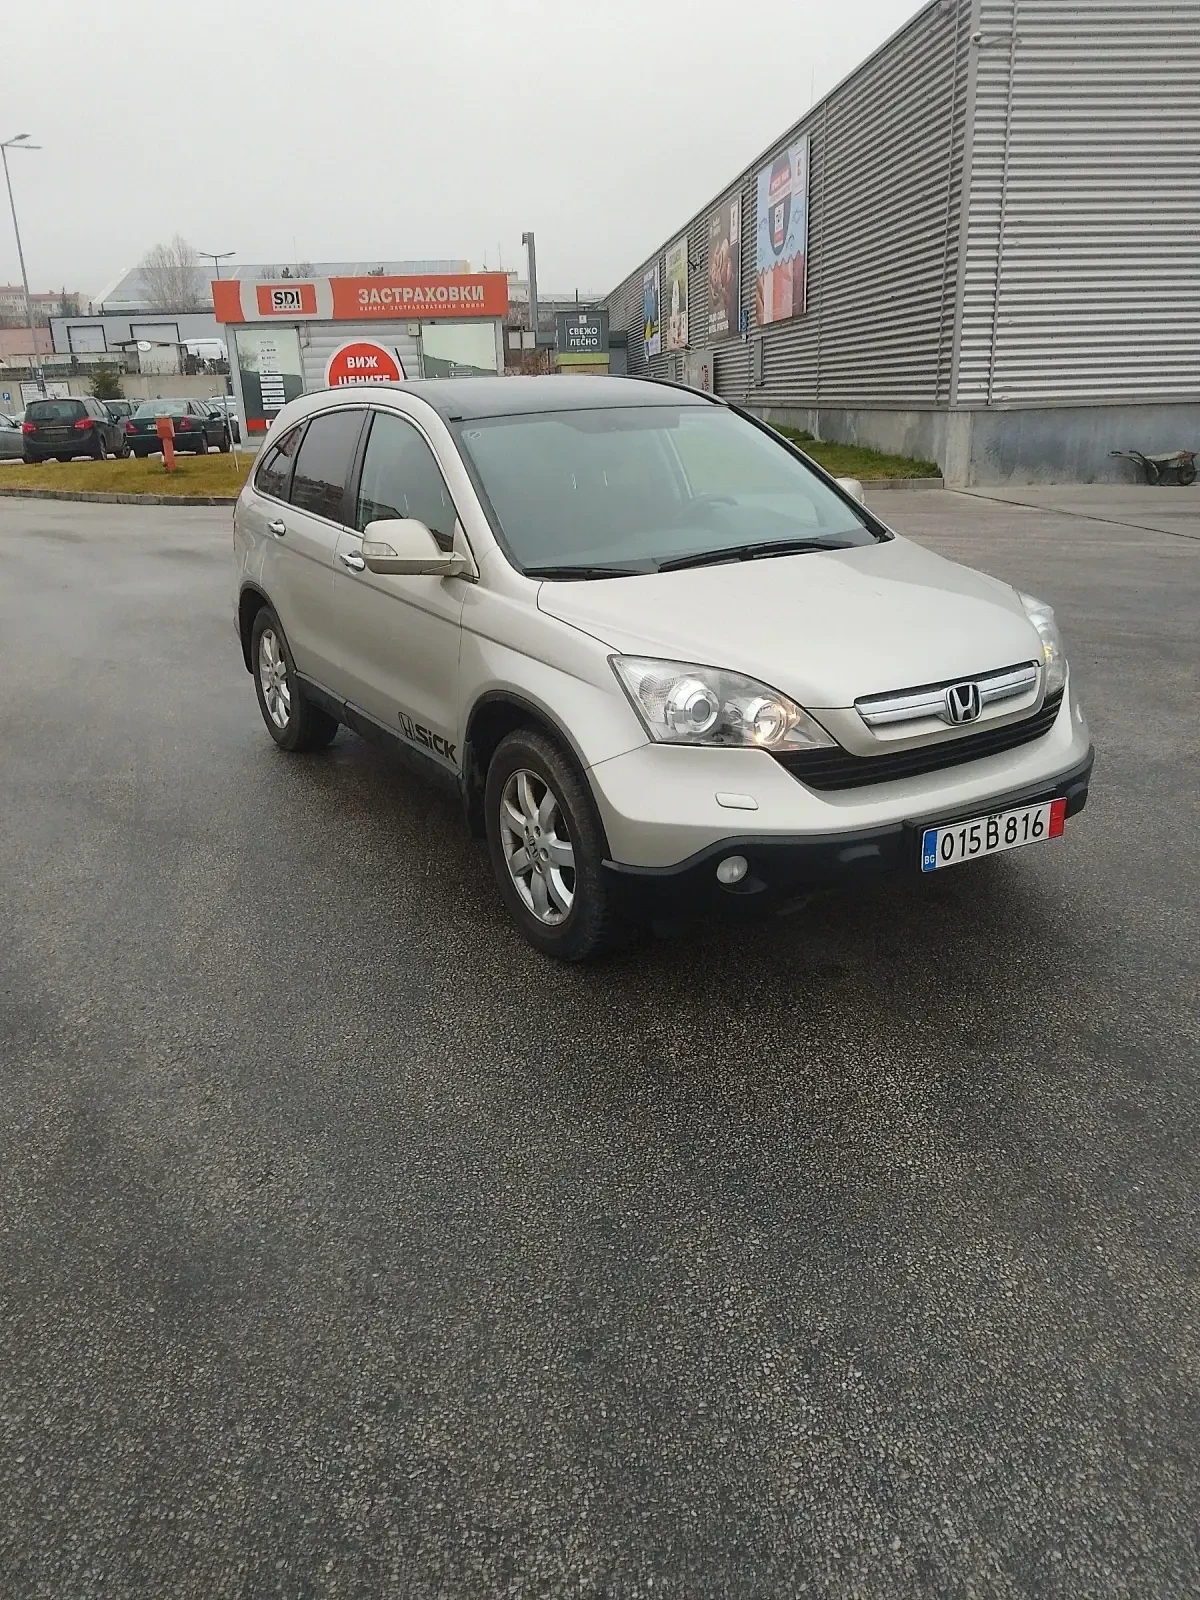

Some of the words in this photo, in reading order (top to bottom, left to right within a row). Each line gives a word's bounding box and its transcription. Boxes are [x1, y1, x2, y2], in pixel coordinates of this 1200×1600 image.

[273, 291, 301, 305] SDI
[358, 286, 485, 303] ЗАСТРАХОВКИ
[569, 327, 598, 335] СВЕЖО
[570, 338, 598, 346] ЛЕСНО
[346, 356, 379, 369] ВИЖ
[924, 854, 935, 865] BG
